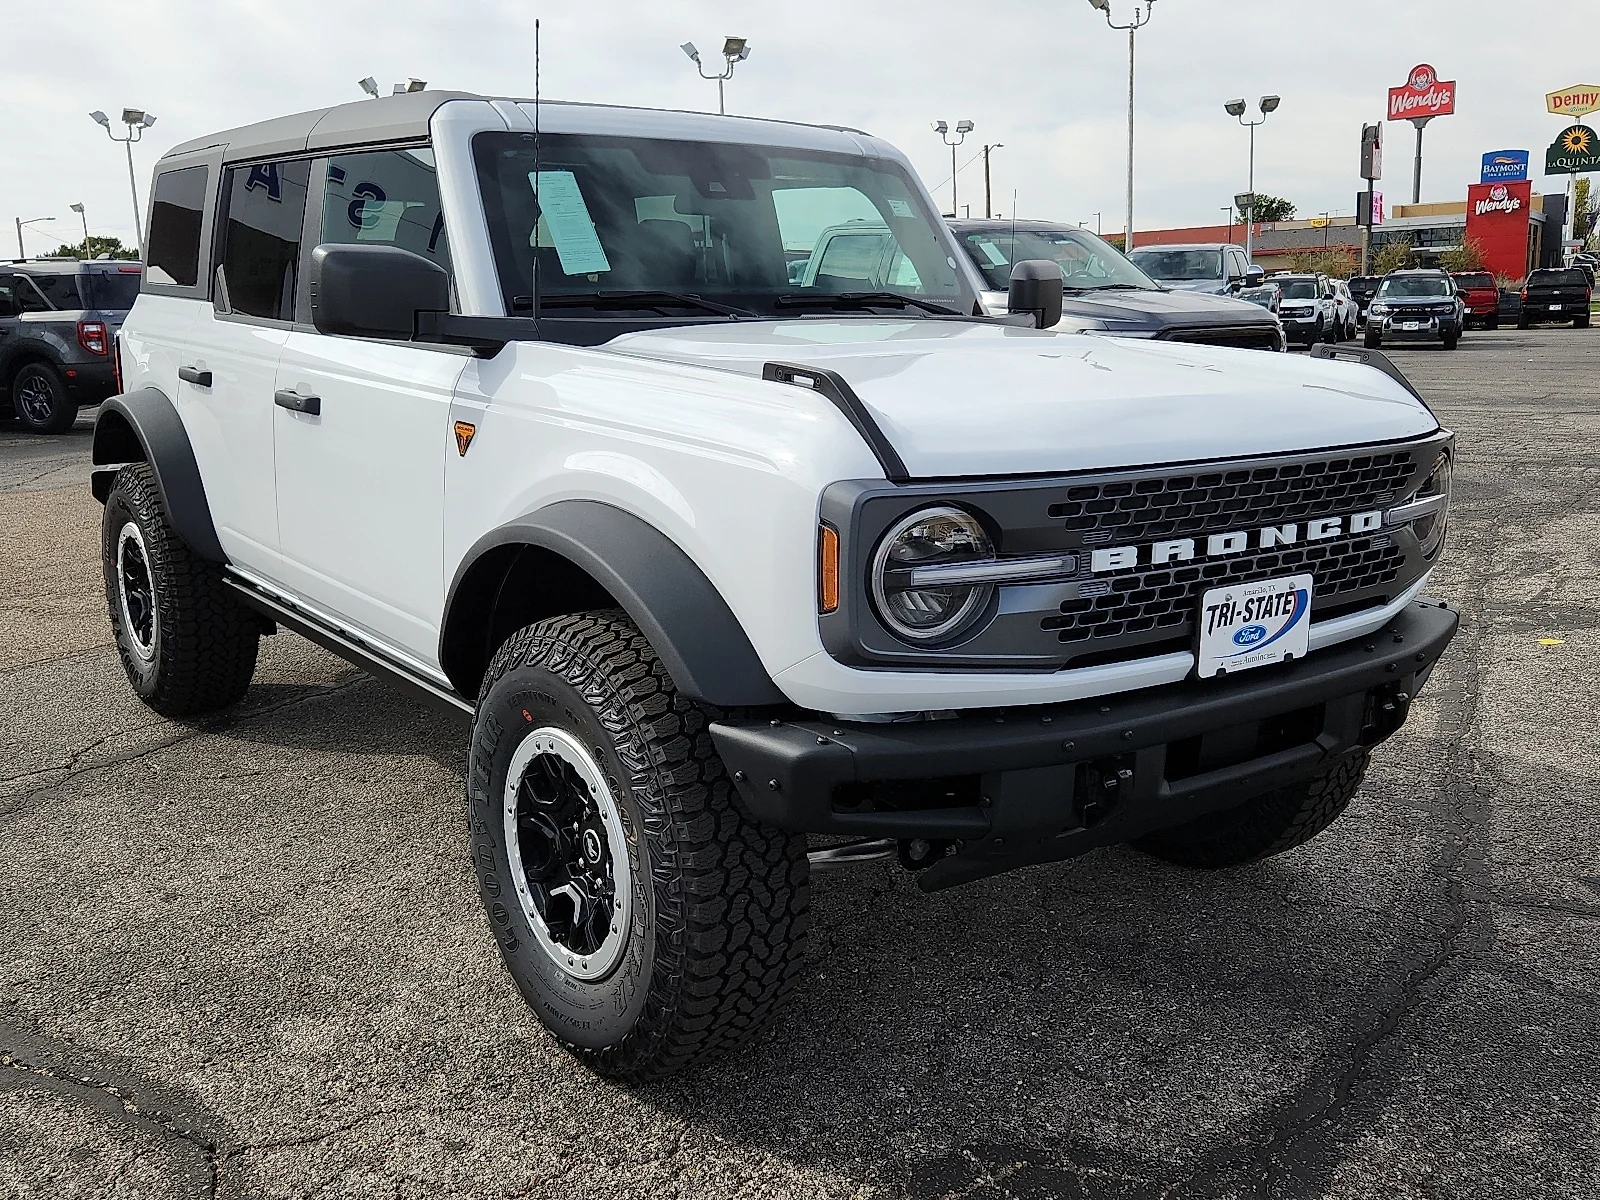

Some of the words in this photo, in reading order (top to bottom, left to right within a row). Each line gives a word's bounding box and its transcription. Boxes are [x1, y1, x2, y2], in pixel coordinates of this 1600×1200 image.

[1391, 85, 1451, 115] Wendy's
[1552, 93, 1599, 109] Denny
[1483, 163, 1526, 173] BAYMONT
[1475, 195, 1521, 216] Wendy's
[1091, 510, 1382, 573] BRONCO
[1268, 584, 1276, 592] TX
[1206, 591, 1295, 637] TRI-STATE
[1238, 627, 1262, 643] Ford
[471, 711, 519, 953] GOODYEAR
